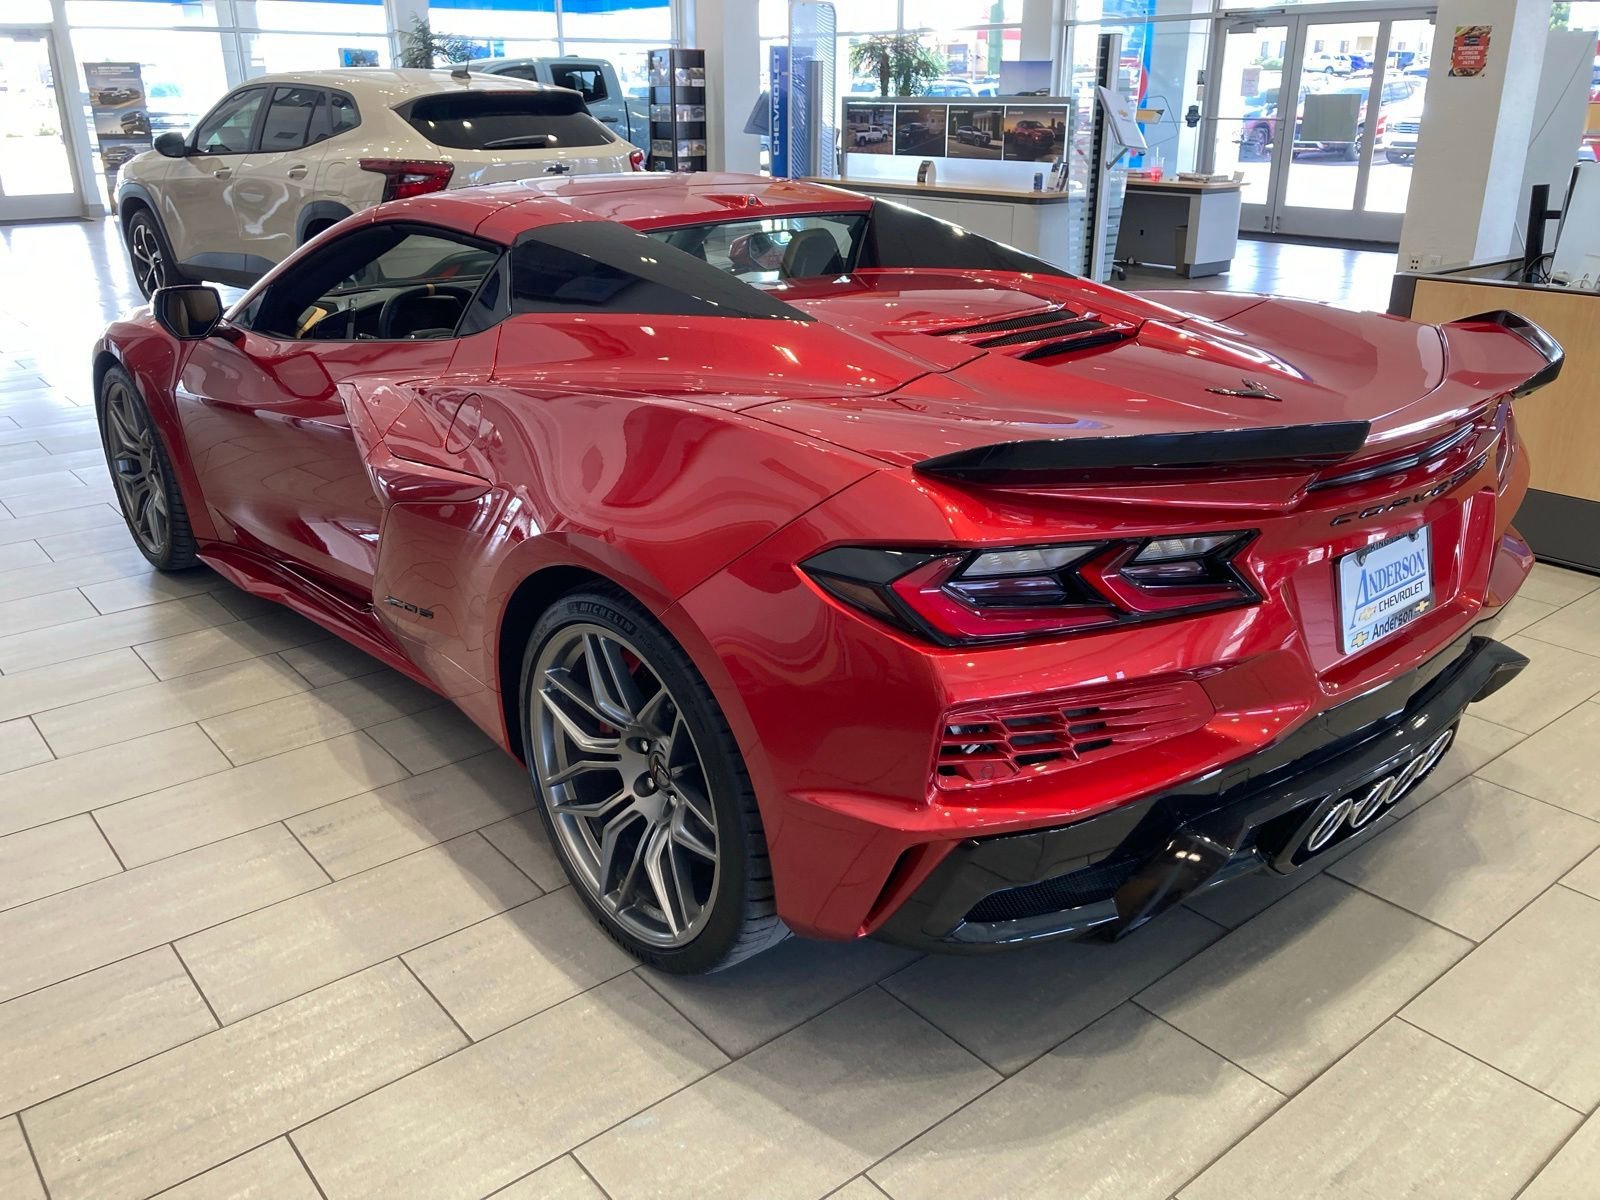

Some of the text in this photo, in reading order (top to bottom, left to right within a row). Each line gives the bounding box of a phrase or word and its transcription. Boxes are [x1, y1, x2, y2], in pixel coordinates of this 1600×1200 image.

[1349, 550, 1426, 630] ANDERSON
[1378, 580, 1425, 613] CHEVROLET
[580, 602, 634, 633] MICHELIN
[1371, 608, 1414, 641] Anderson
